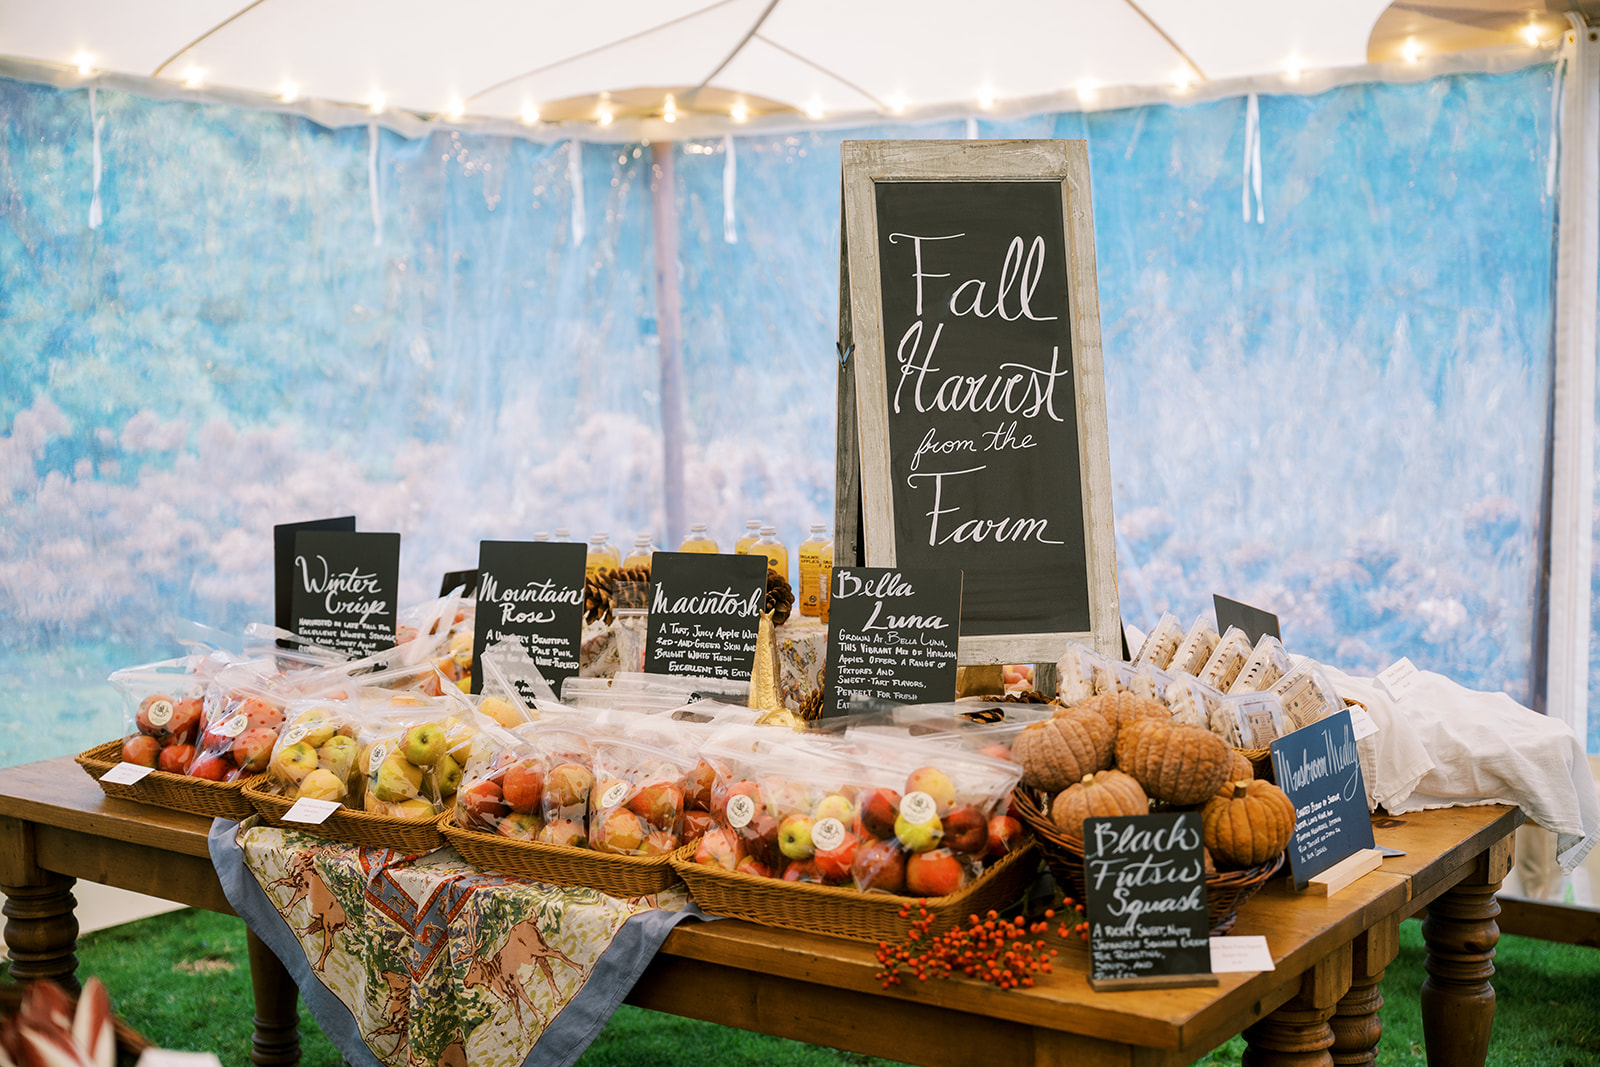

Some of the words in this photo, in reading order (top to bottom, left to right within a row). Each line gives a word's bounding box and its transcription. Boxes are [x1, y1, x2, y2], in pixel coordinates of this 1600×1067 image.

[889, 233, 1058, 321] Fall
[893, 320, 1069, 422] Harvest
[910, 427, 978, 471] from
[982, 421, 1037, 452] the
[907, 465, 1065, 547] Farm
[295, 555, 382, 593] Winter
[479, 572, 585, 605] Mountain
[832, 570, 915, 599] Bella
[325, 590, 390, 624] Crisp
[499, 602, 556, 625] Rose
[652, 582, 762, 618] Macintosh
[862, 600, 950, 632] Luna
[486, 629, 494, 640] A
[659, 622, 666, 634] A
[900, 657, 906, 666] A
[1274, 748, 1328, 794] Mushroom
[1085, 814, 1200, 859] Black
[1090, 854, 1202, 890] Futsu
[1106, 885, 1204, 930] Squash
